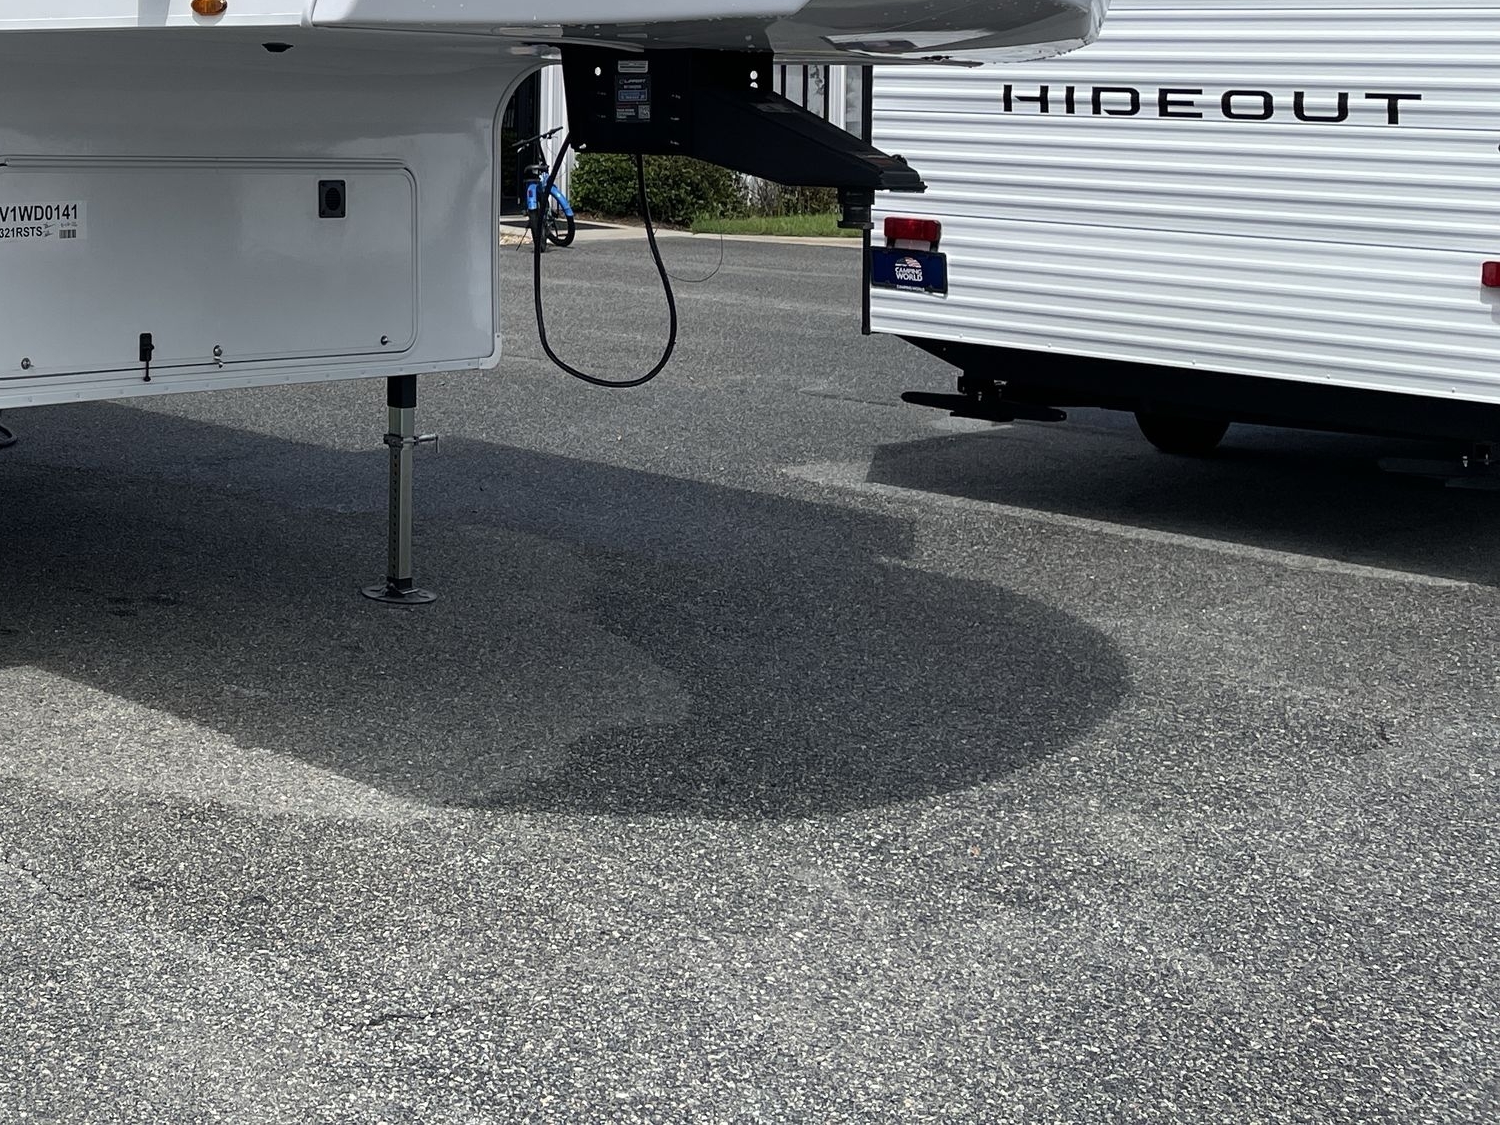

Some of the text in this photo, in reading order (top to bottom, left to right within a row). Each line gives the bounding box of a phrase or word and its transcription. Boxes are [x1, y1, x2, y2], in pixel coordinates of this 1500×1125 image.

[1002, 84, 1422, 125] HIDEOUT
[895, 267, 923, 275] CAMPING
[896, 273, 923, 282] WORLD
